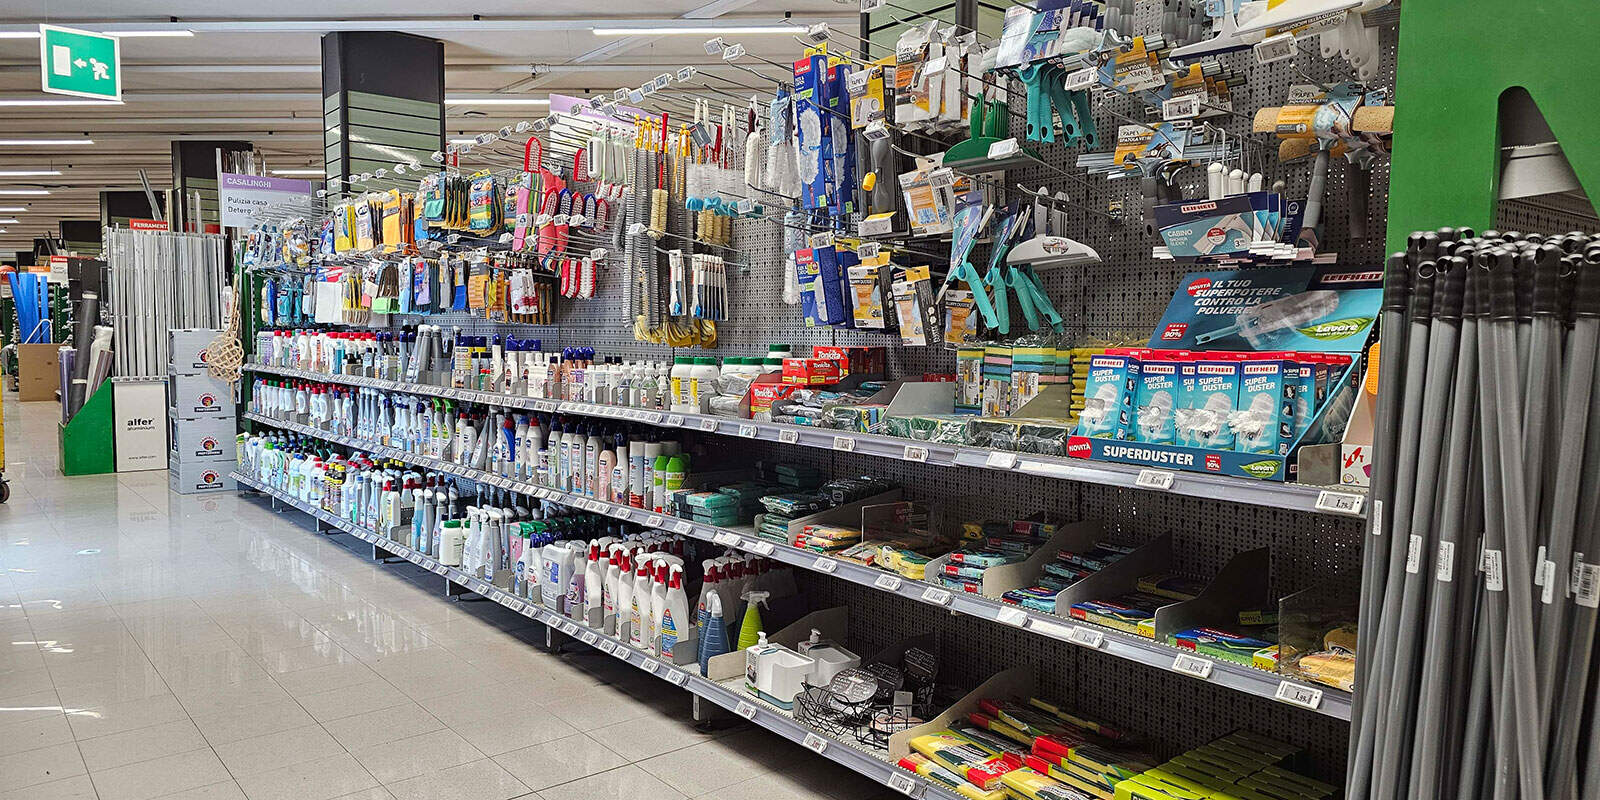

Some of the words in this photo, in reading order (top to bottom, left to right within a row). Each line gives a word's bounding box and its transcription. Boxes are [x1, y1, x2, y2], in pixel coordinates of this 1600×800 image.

[227, 177, 272, 188] CASALINGHI
[227, 196, 251, 205] Pulizia
[1323, 272, 1383, 282] LEIFHEIT
[1187, 282, 1211, 291] NOVITÀ
[1212, 280, 1226, 289] IL
[1226, 279, 1252, 288] TUO
[1193, 287, 1282, 298] SUPERPOTERE
[1194, 297, 1245, 306] CONTRO
[1245, 296, 1262, 305] LA
[1316, 323, 1359, 333] Lavare
[1092, 369, 1114, 377] SUPER
[1095, 374, 1121, 382] DUSTER
[1144, 375, 1165, 384] SUPER
[1198, 376, 1223, 385] SUPER
[1244, 376, 1268, 386] SUPER
[1147, 381, 1173, 390] DUSTER
[1202, 382, 1232, 391] DUSTER
[1248, 382, 1275, 392] DUSTER
[754, 387, 774, 398] Tonkita
[127, 418, 153, 426] alfer
[1069, 442, 1091, 452] NOVITÀ
[1103, 445, 1194, 466] SUPERDUSTER
[1206, 461, 1220, 469] 90%
